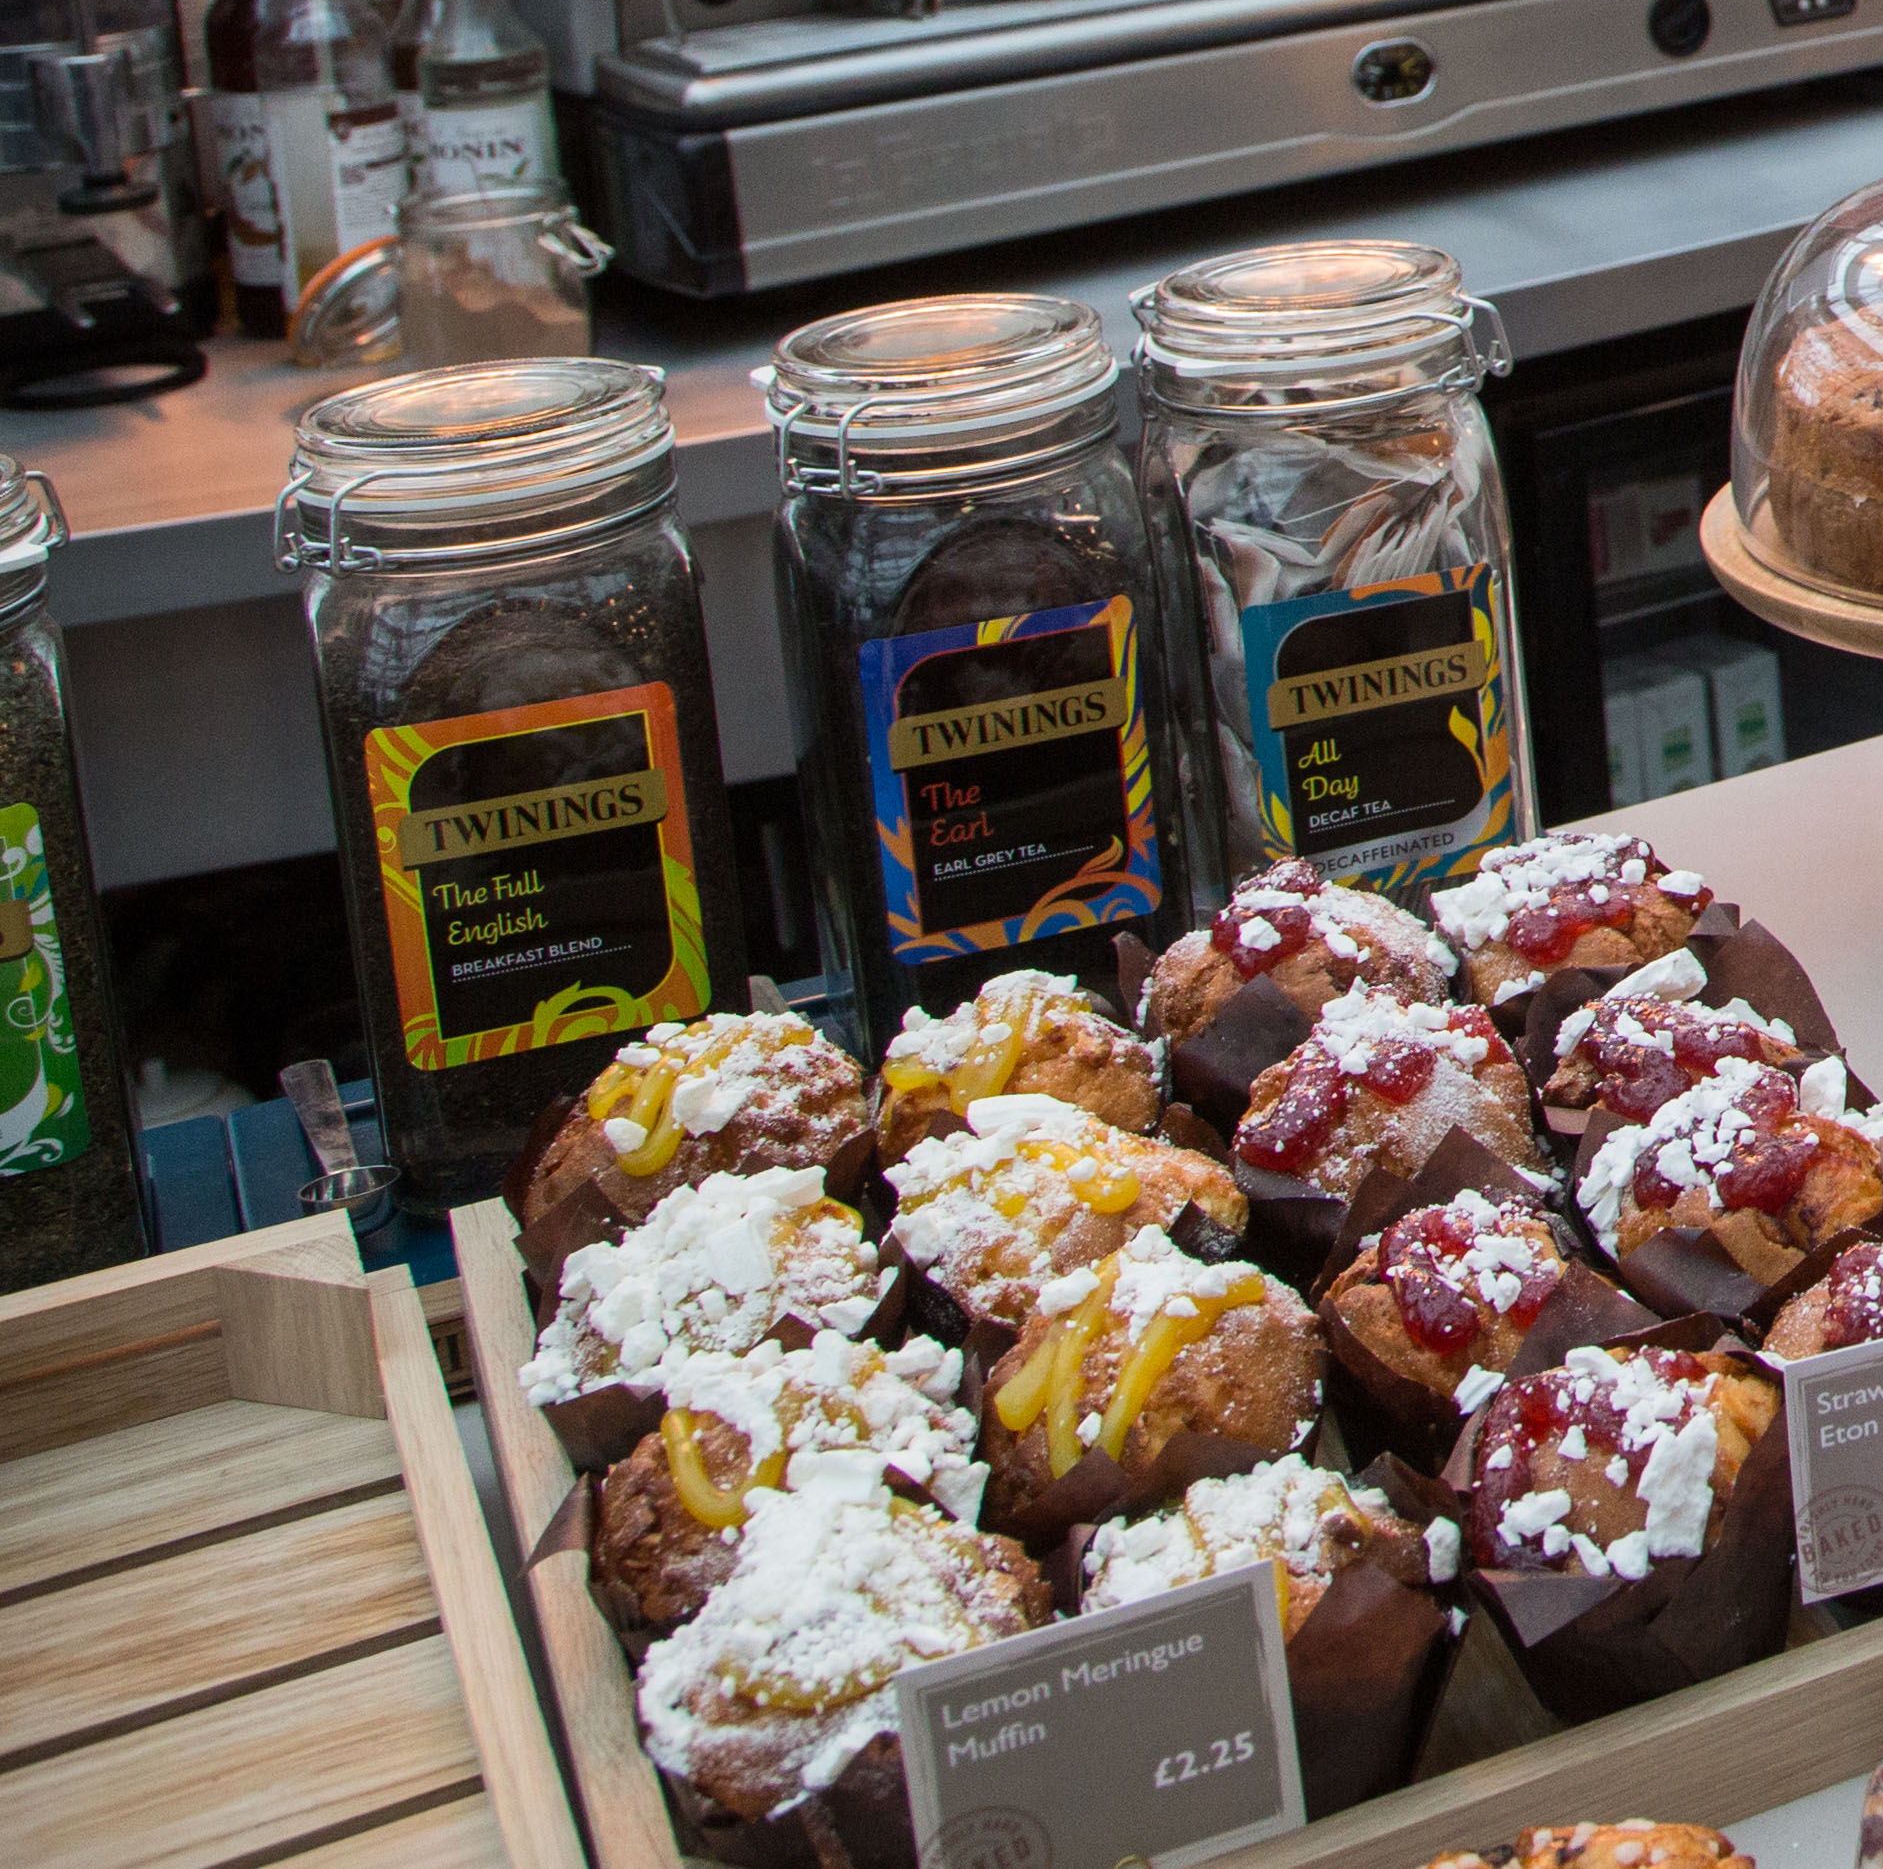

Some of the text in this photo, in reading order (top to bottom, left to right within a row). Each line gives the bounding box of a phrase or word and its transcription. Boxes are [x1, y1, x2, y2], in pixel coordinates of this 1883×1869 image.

[1289, 654, 1467, 715] TWININGS
[912, 691, 1107, 755] TWININGS
[1298, 738, 1342, 768] All
[920, 782, 981, 811] The
[1303, 775, 1359, 800] Day
[425, 784, 644, 851] TWININGS
[930, 811, 994, 846] Earl
[1309, 800, 1392, 827] DECAF TEA
[934, 843, 1047, 875] EARL GREY TEA
[1318, 833, 1455, 875] DECAFFEINATED
[432, 869, 545, 910] The Full
[448, 908, 548, 945] English
[453, 937, 602, 977] BREAKFAST BLEND
[1820, 1420, 1878, 1448] Eton
[1801, 1514, 1882, 1563] BAKED
[942, 1634, 1203, 1729] Lemon Meringue
[947, 1721, 1047, 1767] Muffin
[1155, 1731, 1255, 1789] £2.25
